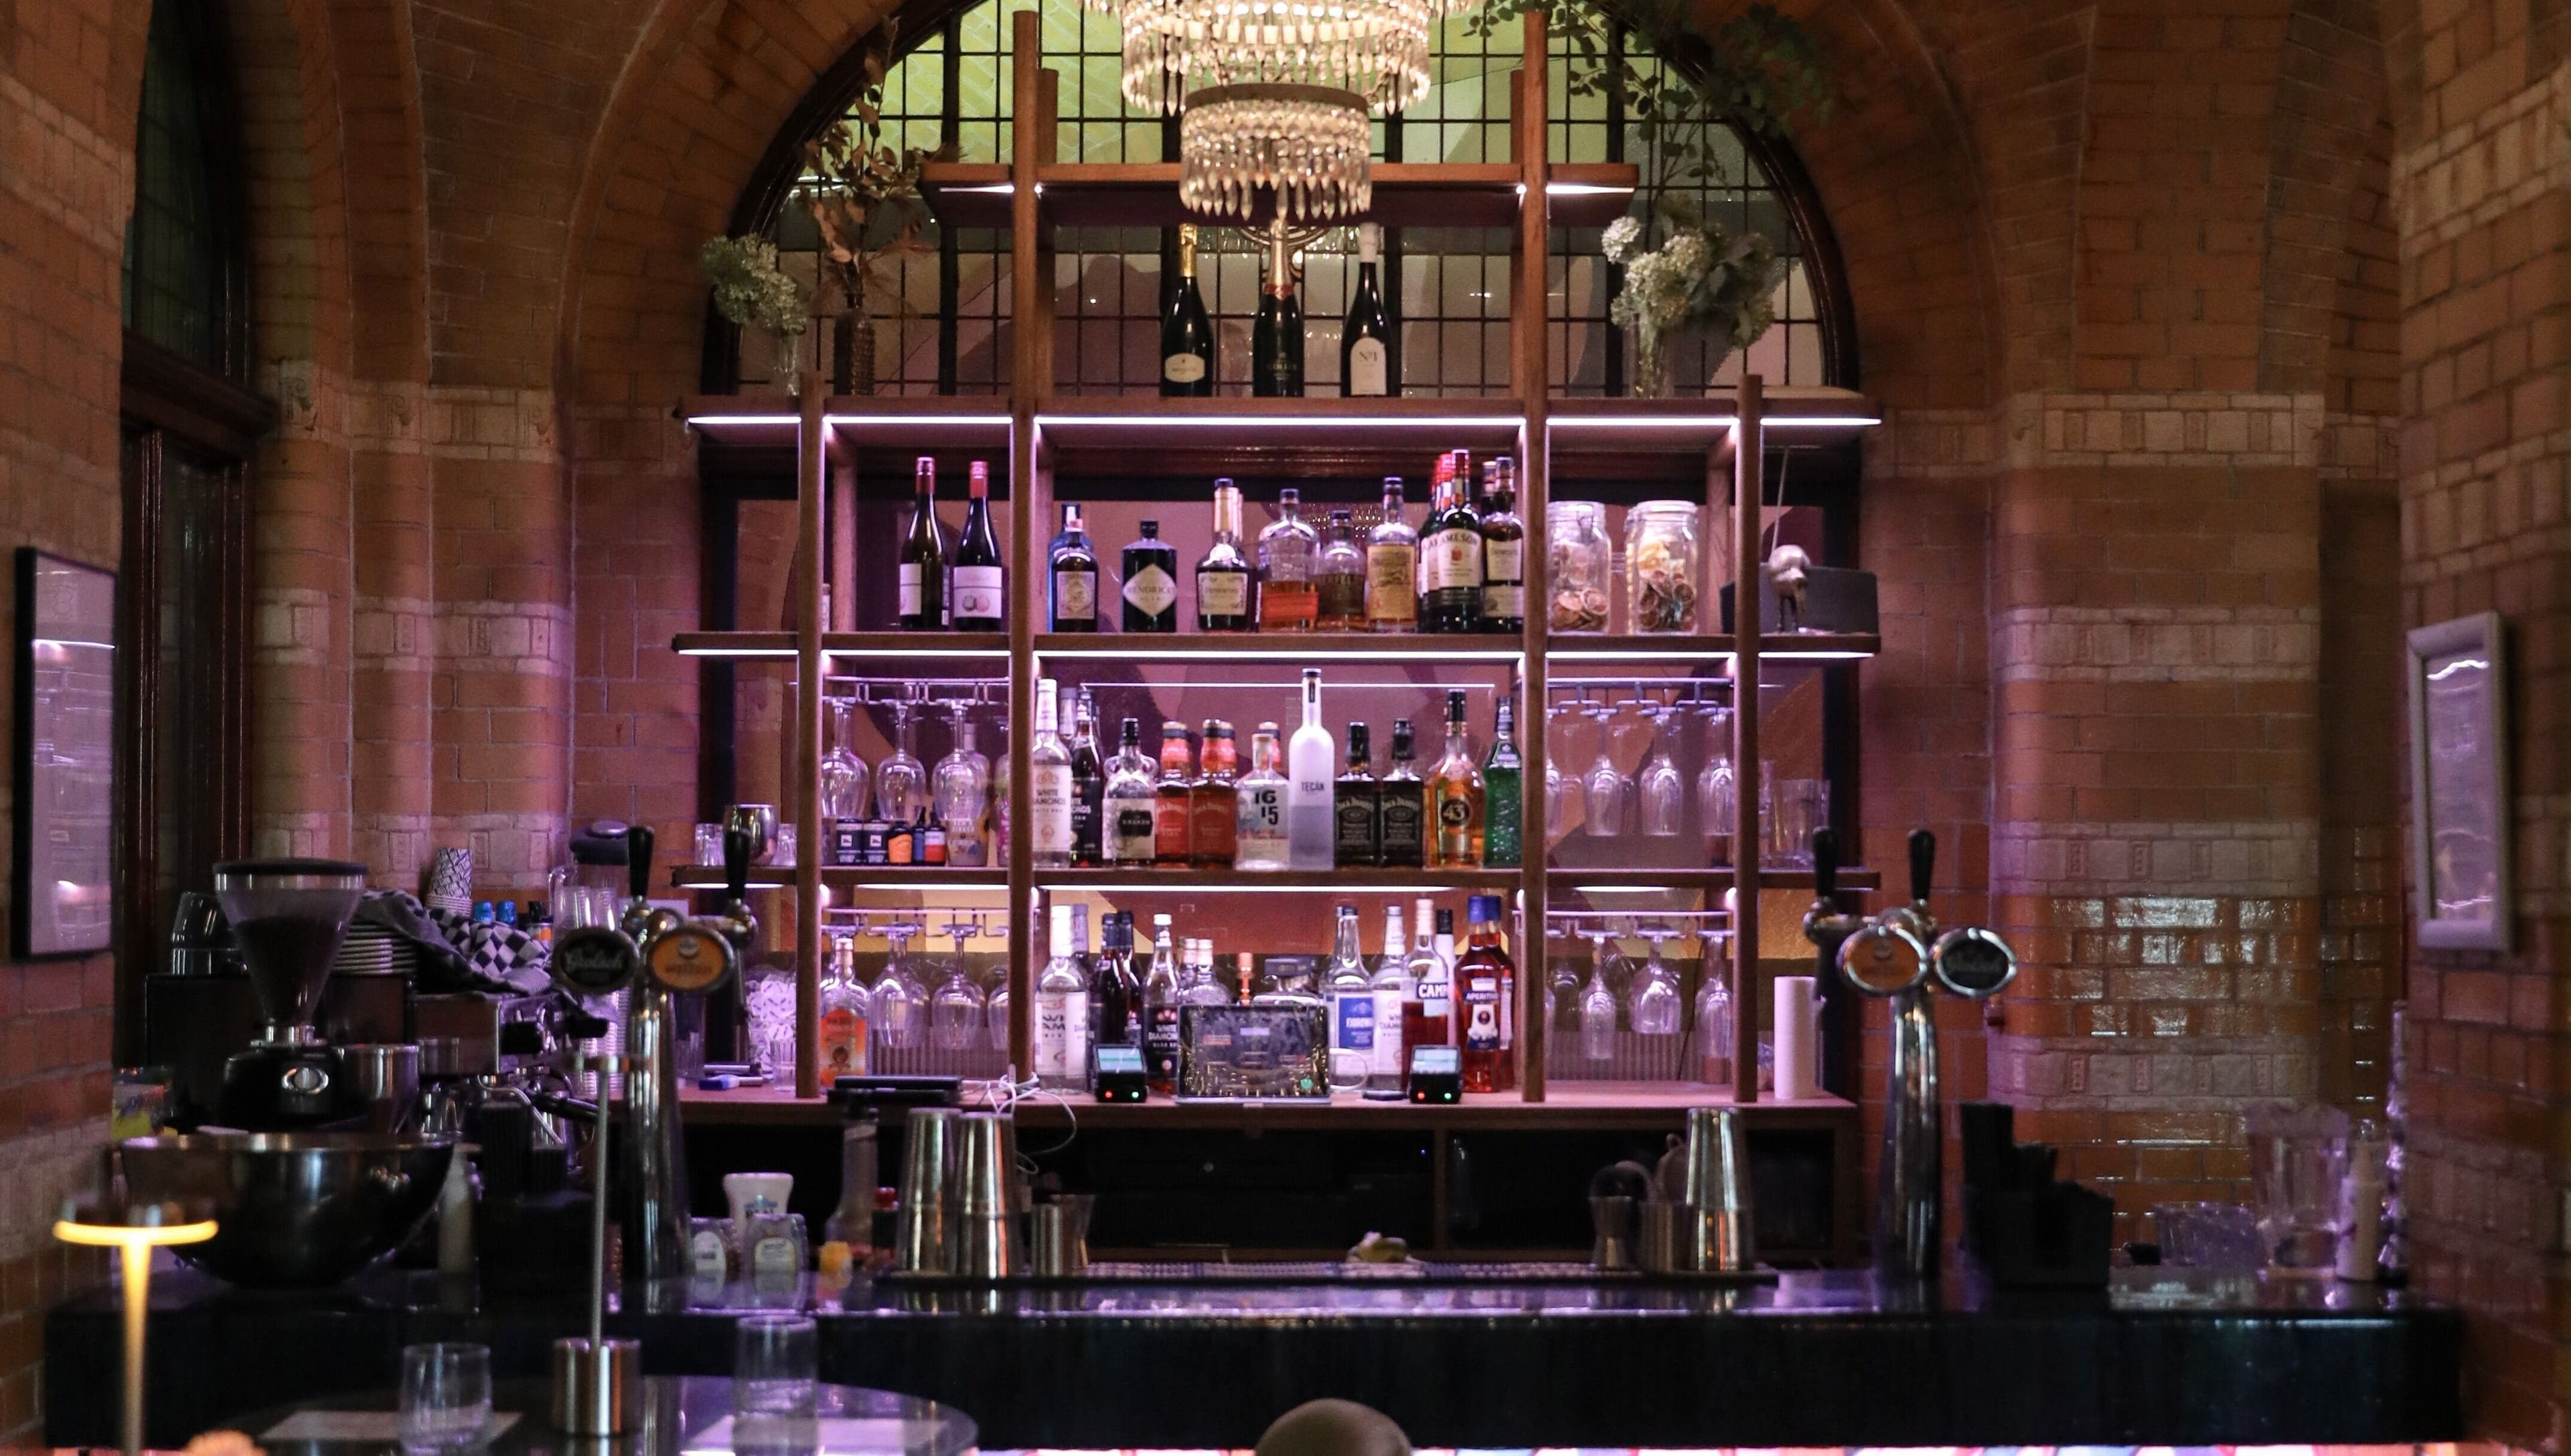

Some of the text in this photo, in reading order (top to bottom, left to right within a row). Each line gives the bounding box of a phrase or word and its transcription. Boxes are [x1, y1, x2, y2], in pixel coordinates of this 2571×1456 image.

[1255, 790, 1277, 805] 16
[1261, 806, 1279, 825] 15
[1442, 803, 1465, 820] 43
[1418, 984, 1448, 999] CAMP
